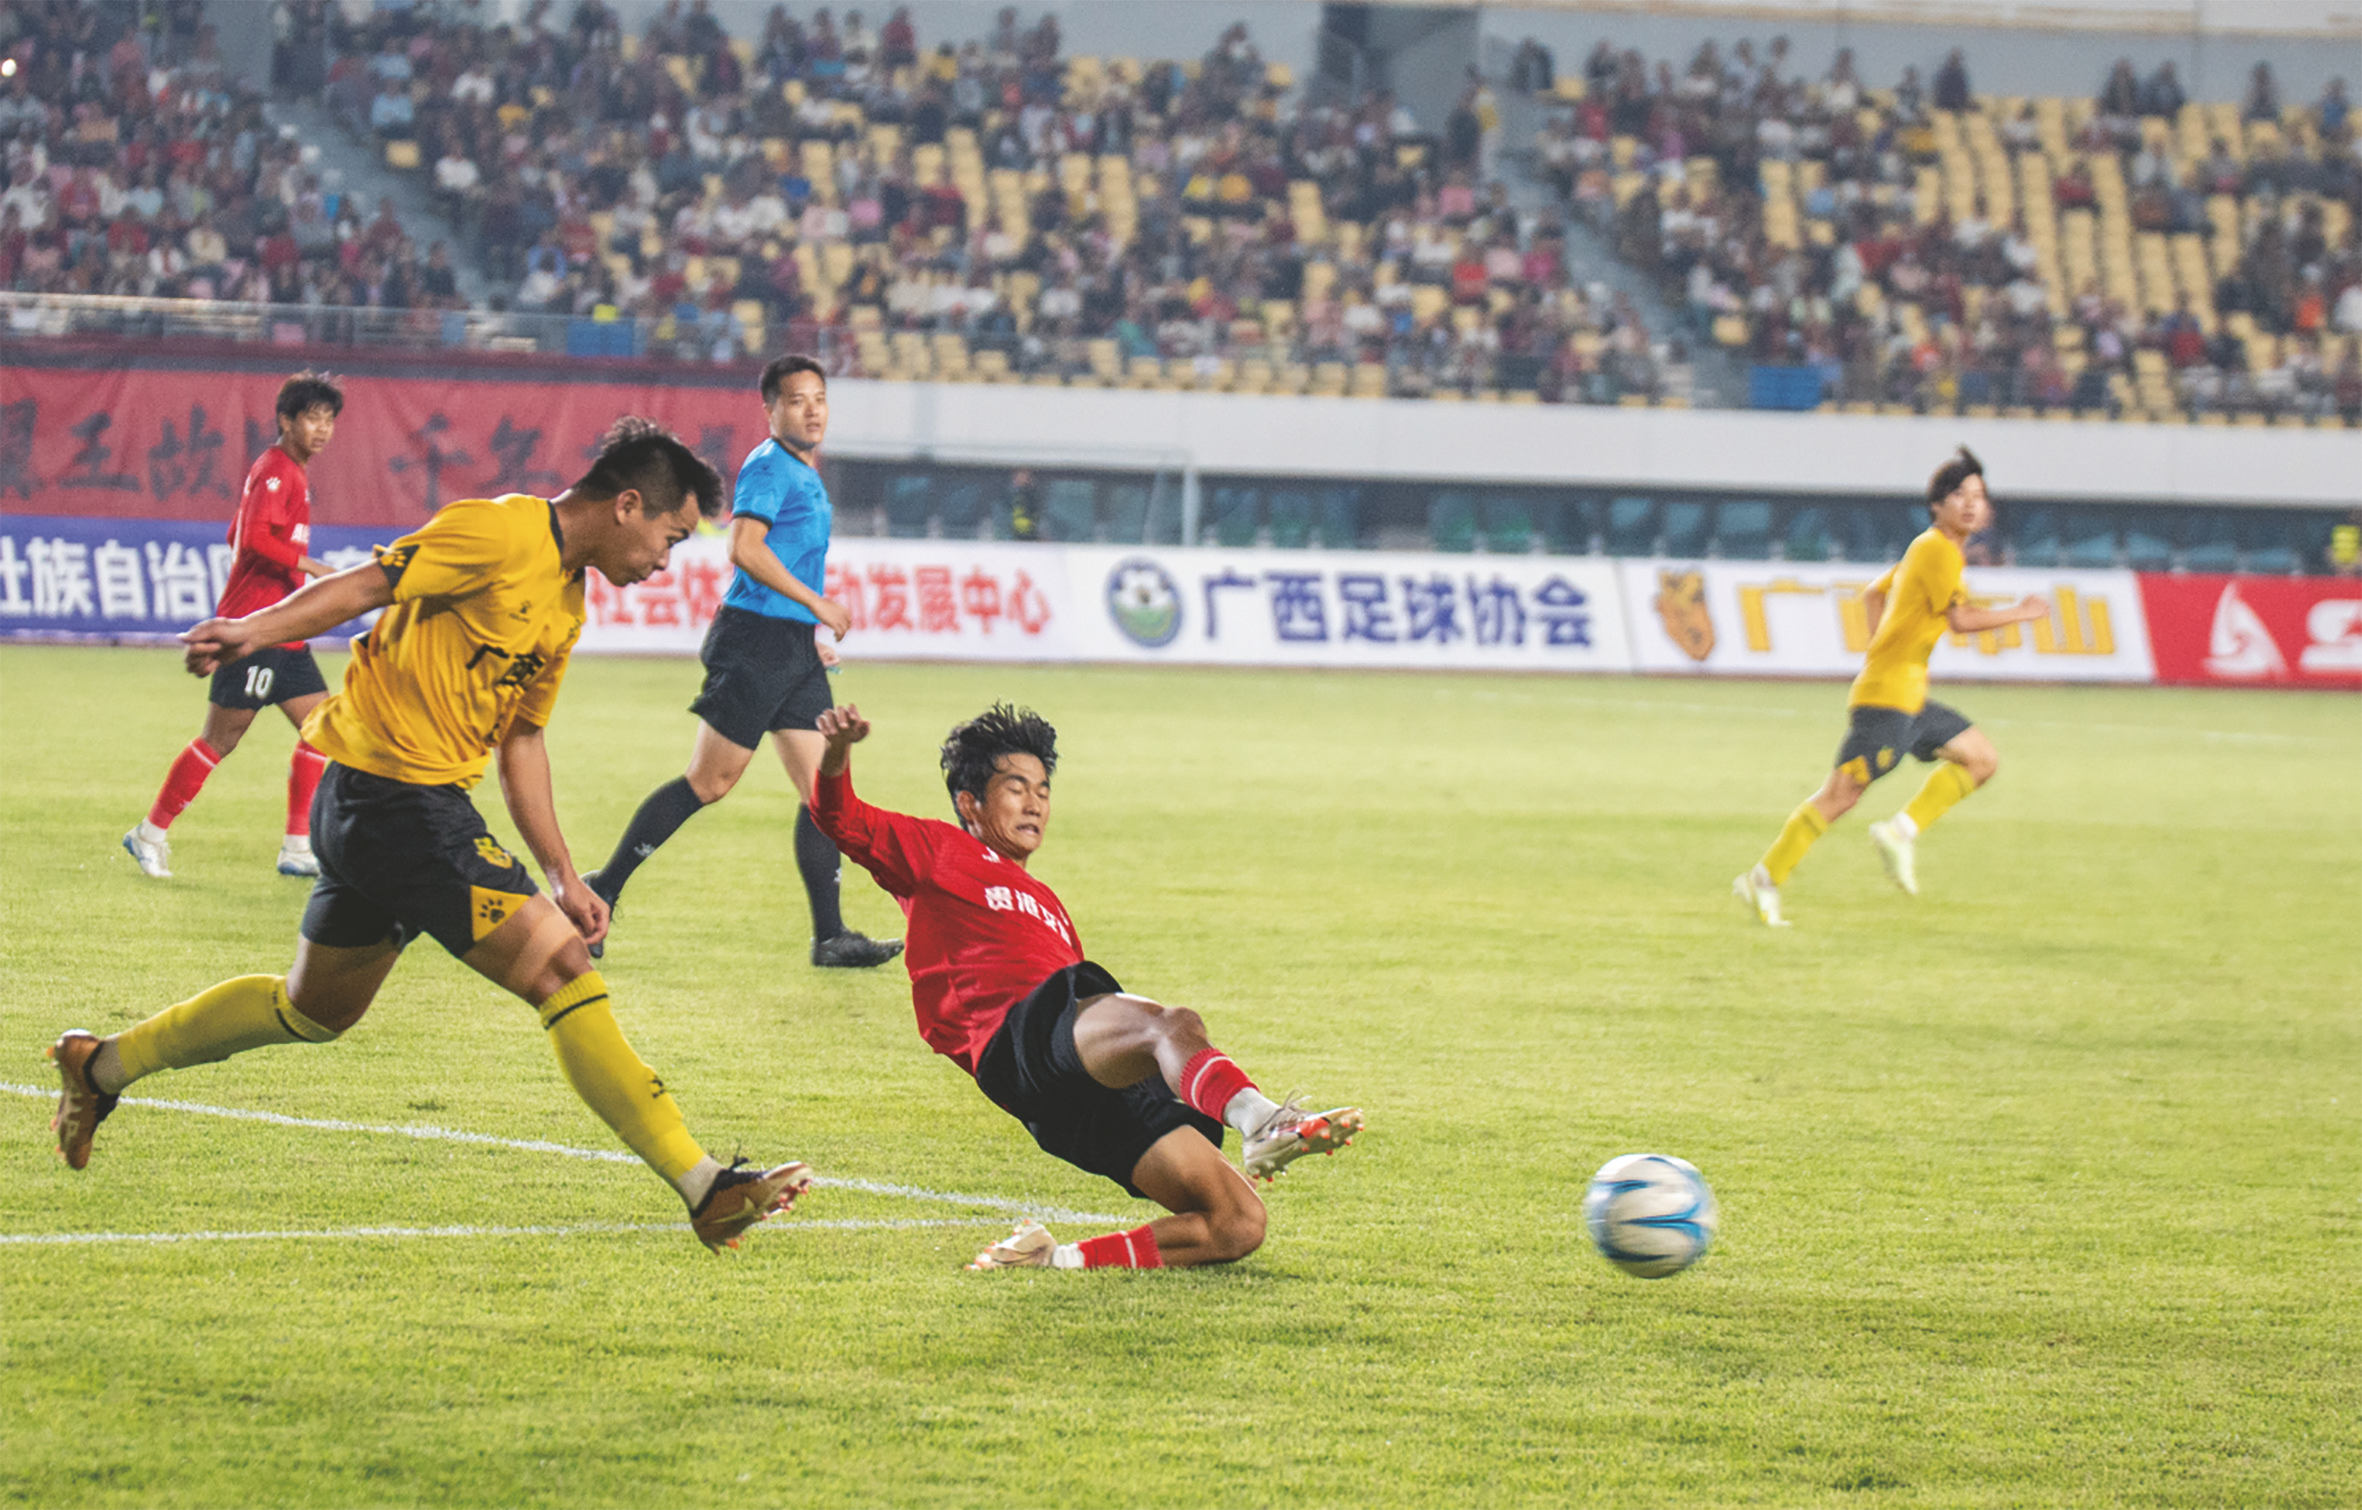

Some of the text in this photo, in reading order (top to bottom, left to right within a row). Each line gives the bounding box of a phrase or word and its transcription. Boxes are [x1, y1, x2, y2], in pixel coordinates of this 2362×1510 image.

[1202, 568, 1593, 648] 广西足球协会
[244, 665, 274, 699] 10
